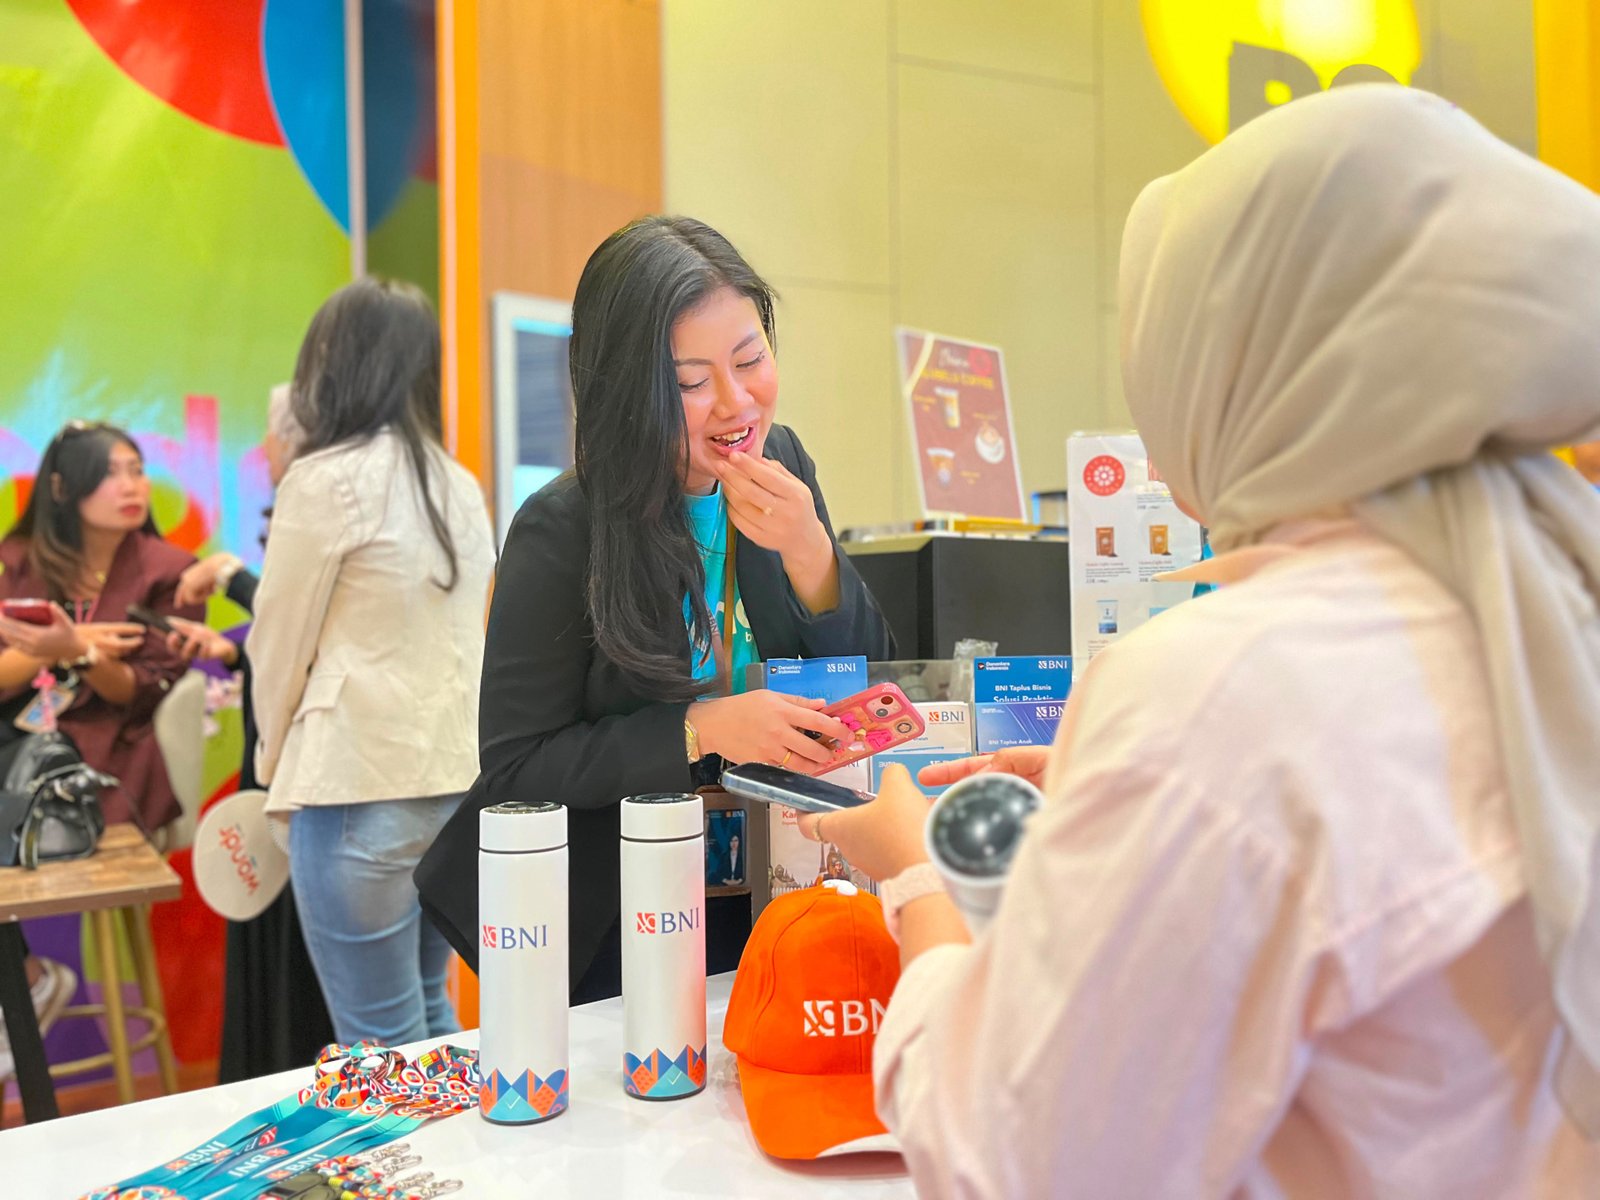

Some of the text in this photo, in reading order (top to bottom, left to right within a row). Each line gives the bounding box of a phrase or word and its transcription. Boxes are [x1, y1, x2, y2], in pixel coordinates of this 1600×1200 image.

[837, 663, 856, 673] BNI
[1048, 660, 1068, 669] BNI
[1009, 684, 1031, 692] Taplus
[941, 711, 964, 722] BNI
[660, 906, 700, 934] BNI
[500, 924, 547, 949] BNI
[839, 998, 888, 1036] BN
[184, 1140, 227, 1161] BNI
[228, 1155, 271, 1177] BNI
[286, 1153, 328, 1171] BNI
